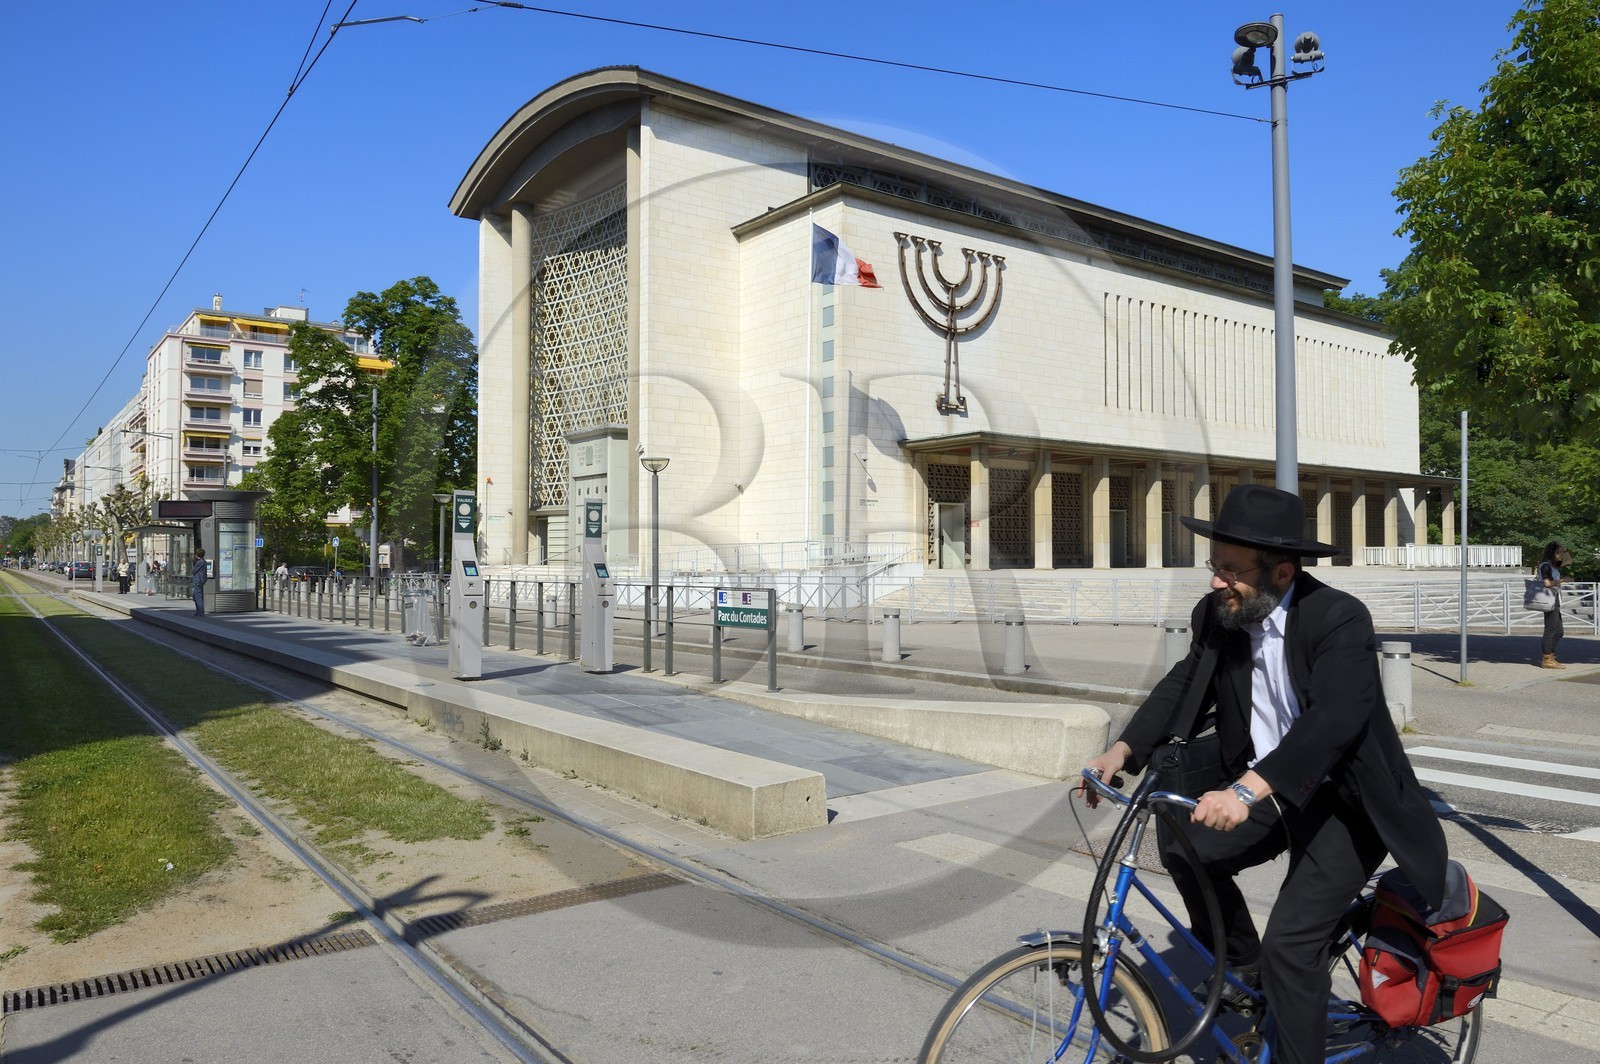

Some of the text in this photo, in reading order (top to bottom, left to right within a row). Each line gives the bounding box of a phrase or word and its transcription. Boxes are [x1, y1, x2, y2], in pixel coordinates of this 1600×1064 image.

[718, 610, 767, 624] Parc du Contades
